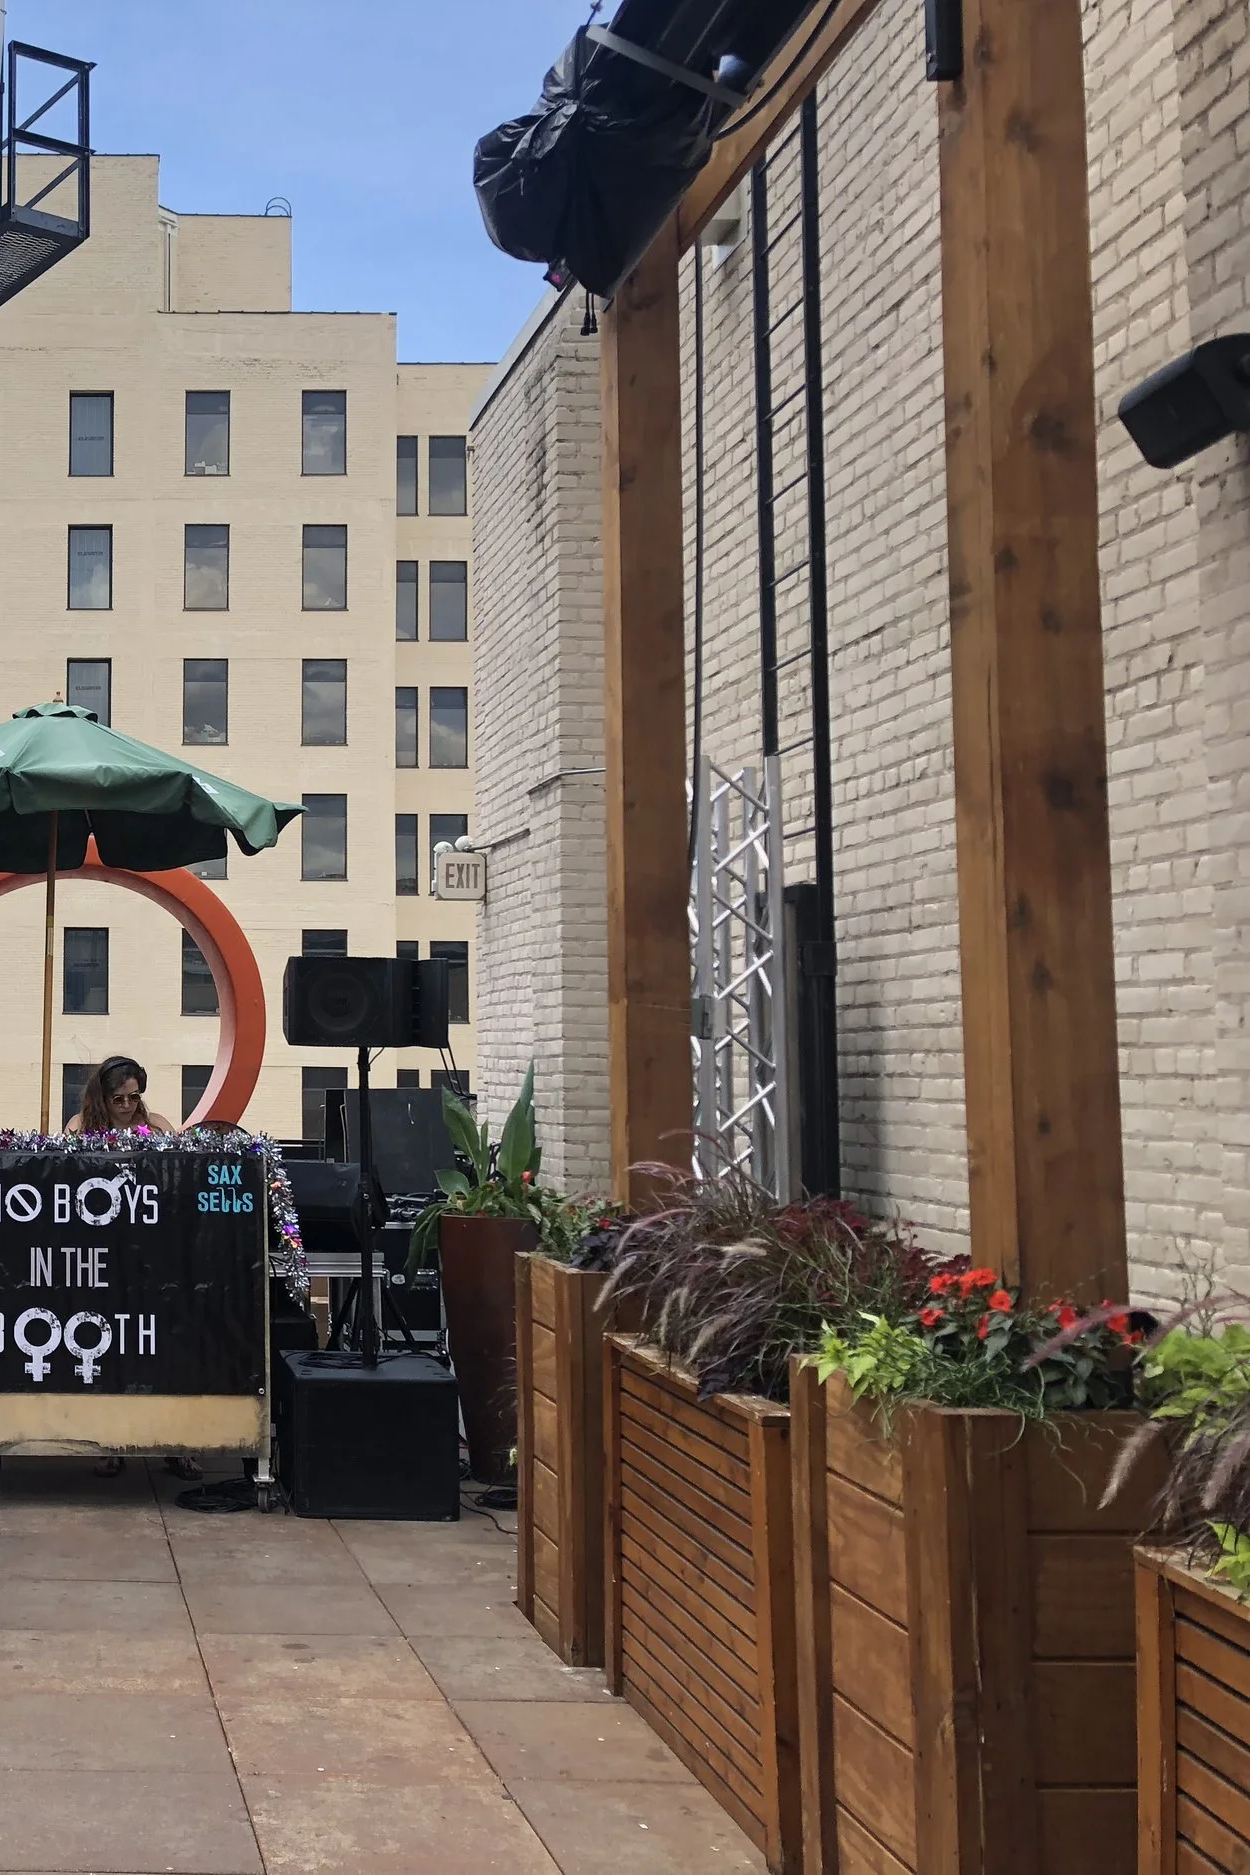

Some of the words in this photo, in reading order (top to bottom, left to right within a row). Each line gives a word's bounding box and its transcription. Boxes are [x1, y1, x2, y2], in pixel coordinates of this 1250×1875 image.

[445, 863, 480, 889] EXIT
[207, 1164, 242, 1185] SAX
[53, 1163, 159, 1226] BOYS
[197, 1187, 254, 1213] SELLS
[30, 1247, 52, 1287] IN
[60, 1247, 109, 1288] THE
